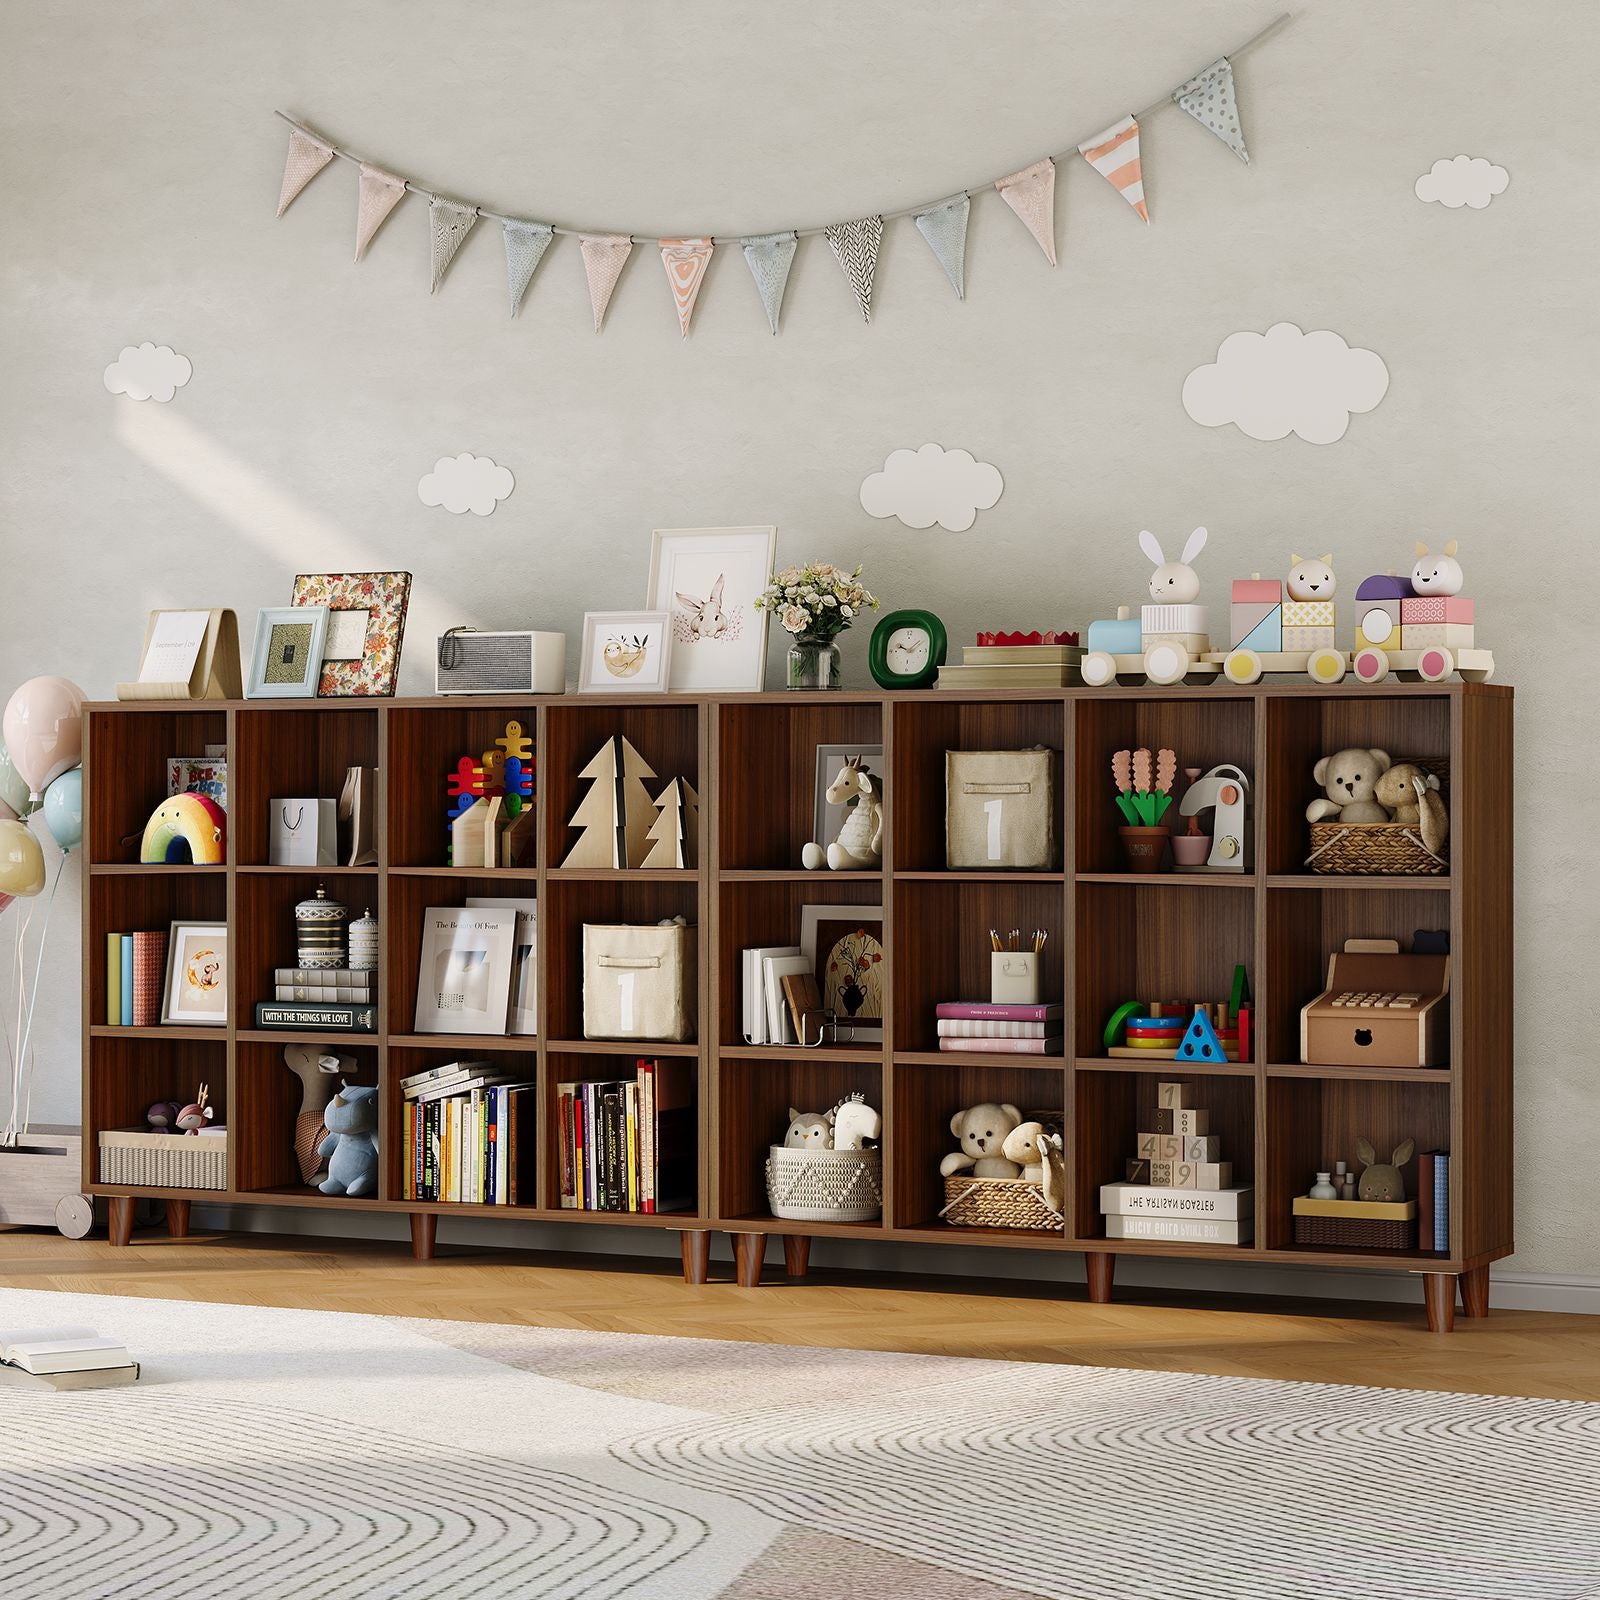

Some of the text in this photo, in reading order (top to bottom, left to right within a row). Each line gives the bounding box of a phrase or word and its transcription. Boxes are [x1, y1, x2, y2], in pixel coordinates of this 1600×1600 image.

[983, 799, 1003, 860] 1
[436, 921, 448, 929] The
[474, 922, 483, 930] Of
[484, 922, 499, 930] Font
[617, 972, 635, 1031] 1
[264, 1011, 348, 1023] WITH THE THINGS WE LOVE
[1164, 1085, 1174, 1107] 1
[1141, 1136, 1156, 1157] 4
[1164, 1137, 1179, 1158] 5
[1189, 1139, 1202, 1160] 6
[1130, 1161, 1144, 1182] 7
[1178, 1164, 1191, 1185] 9
